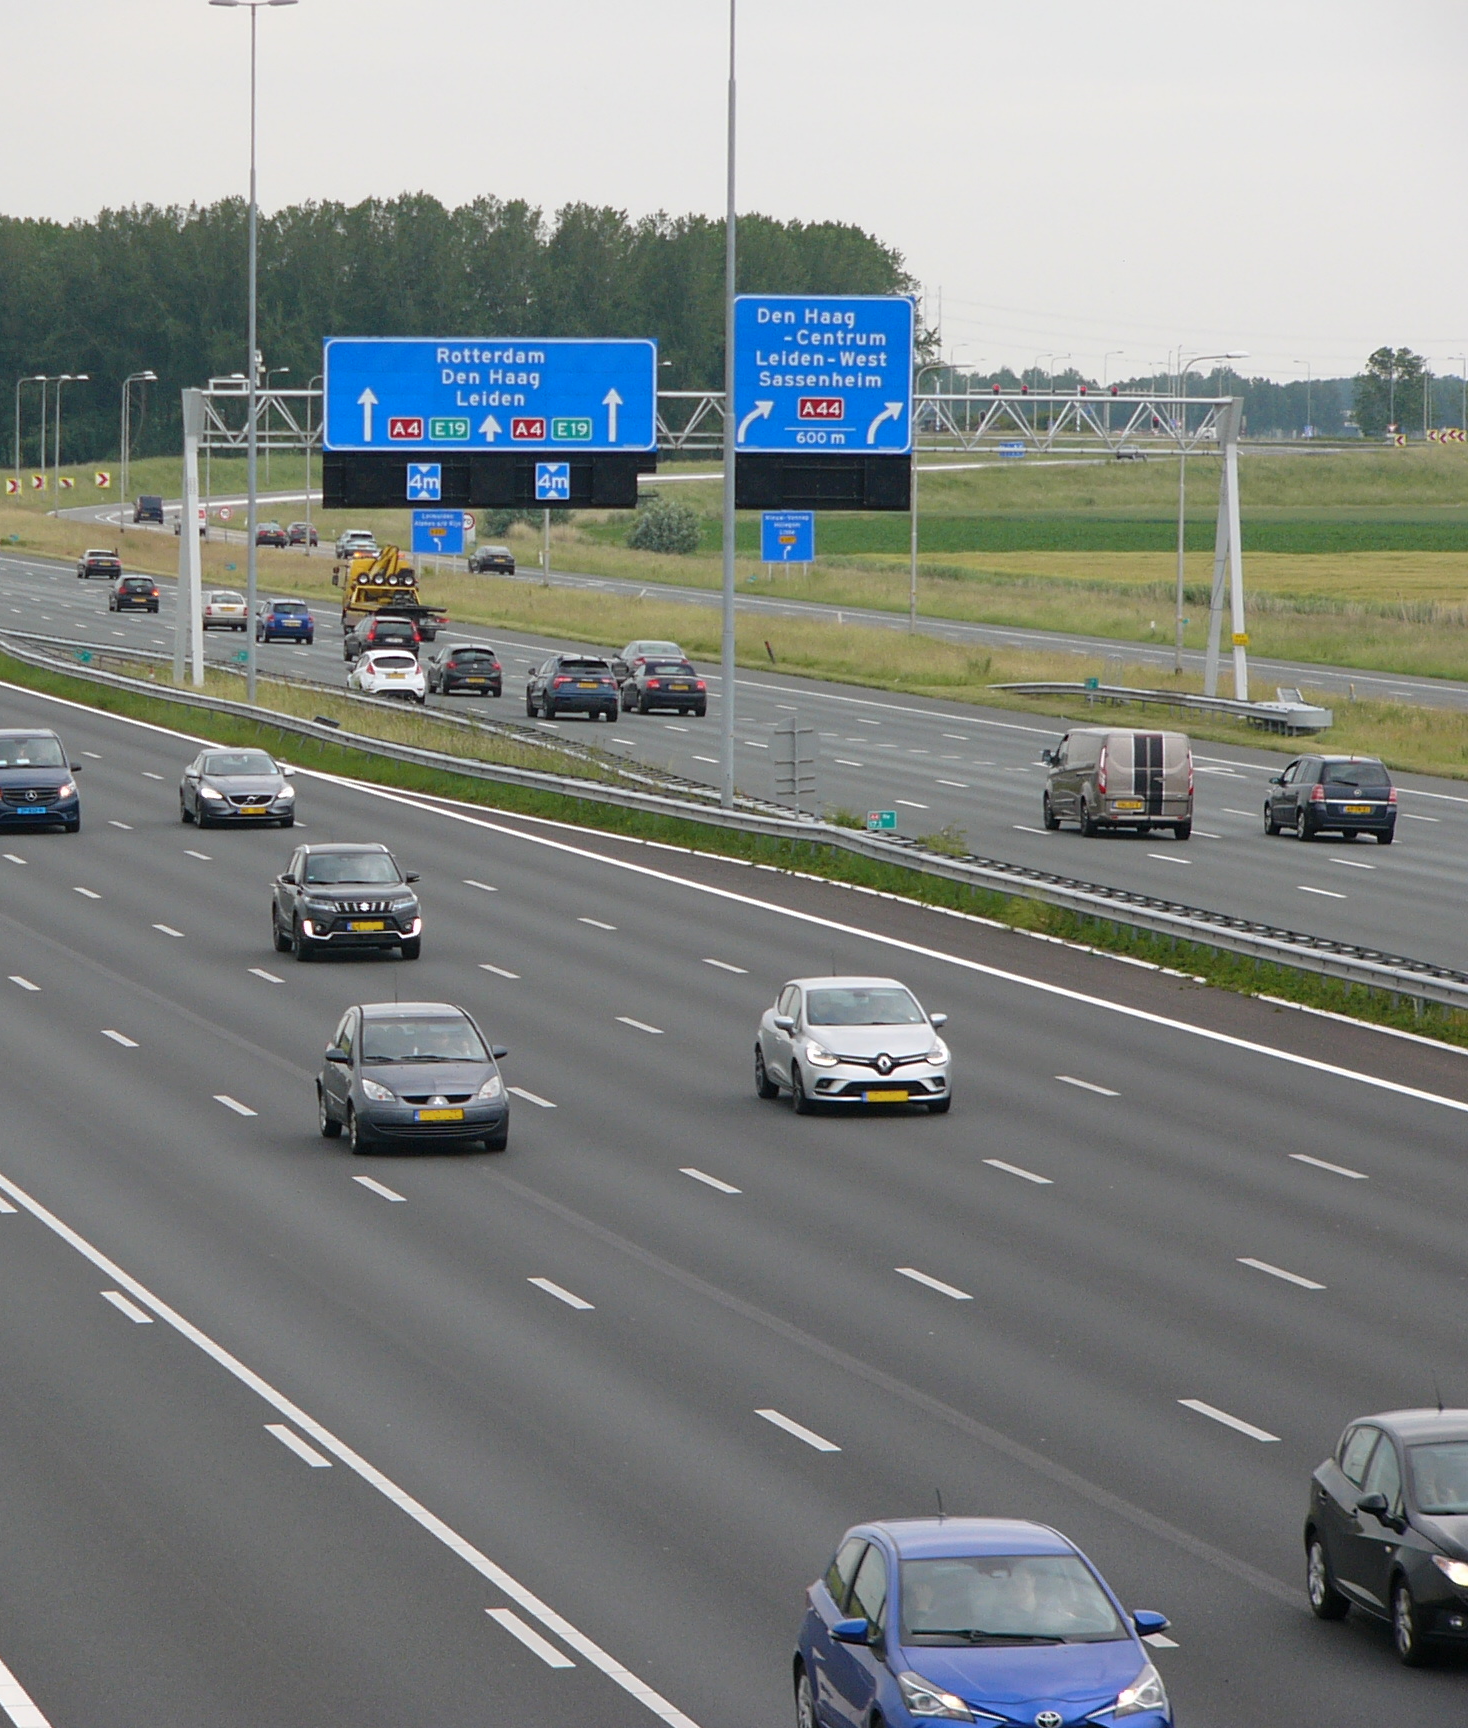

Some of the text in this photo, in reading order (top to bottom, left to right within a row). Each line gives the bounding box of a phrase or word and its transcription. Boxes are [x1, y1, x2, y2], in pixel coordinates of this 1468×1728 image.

[758, 308, 855, 328] Den Haag
[784, 329, 886, 345] -Centrum
[437, 348, 545, 363] Rotterdam
[756, 350, 887, 366] Leiden-West
[442, 370, 540, 389] Den Haag
[759, 371, 882, 387] Sassenheim
[456, 391, 525, 406] Leiden
[802, 402, 840, 415] A44
[393, 422, 420, 436] A4
[515, 422, 542, 436] A4
[796, 432, 845, 444] 600 m
[409, 475, 439, 489] 4m
[538, 475, 568, 489] 4m
